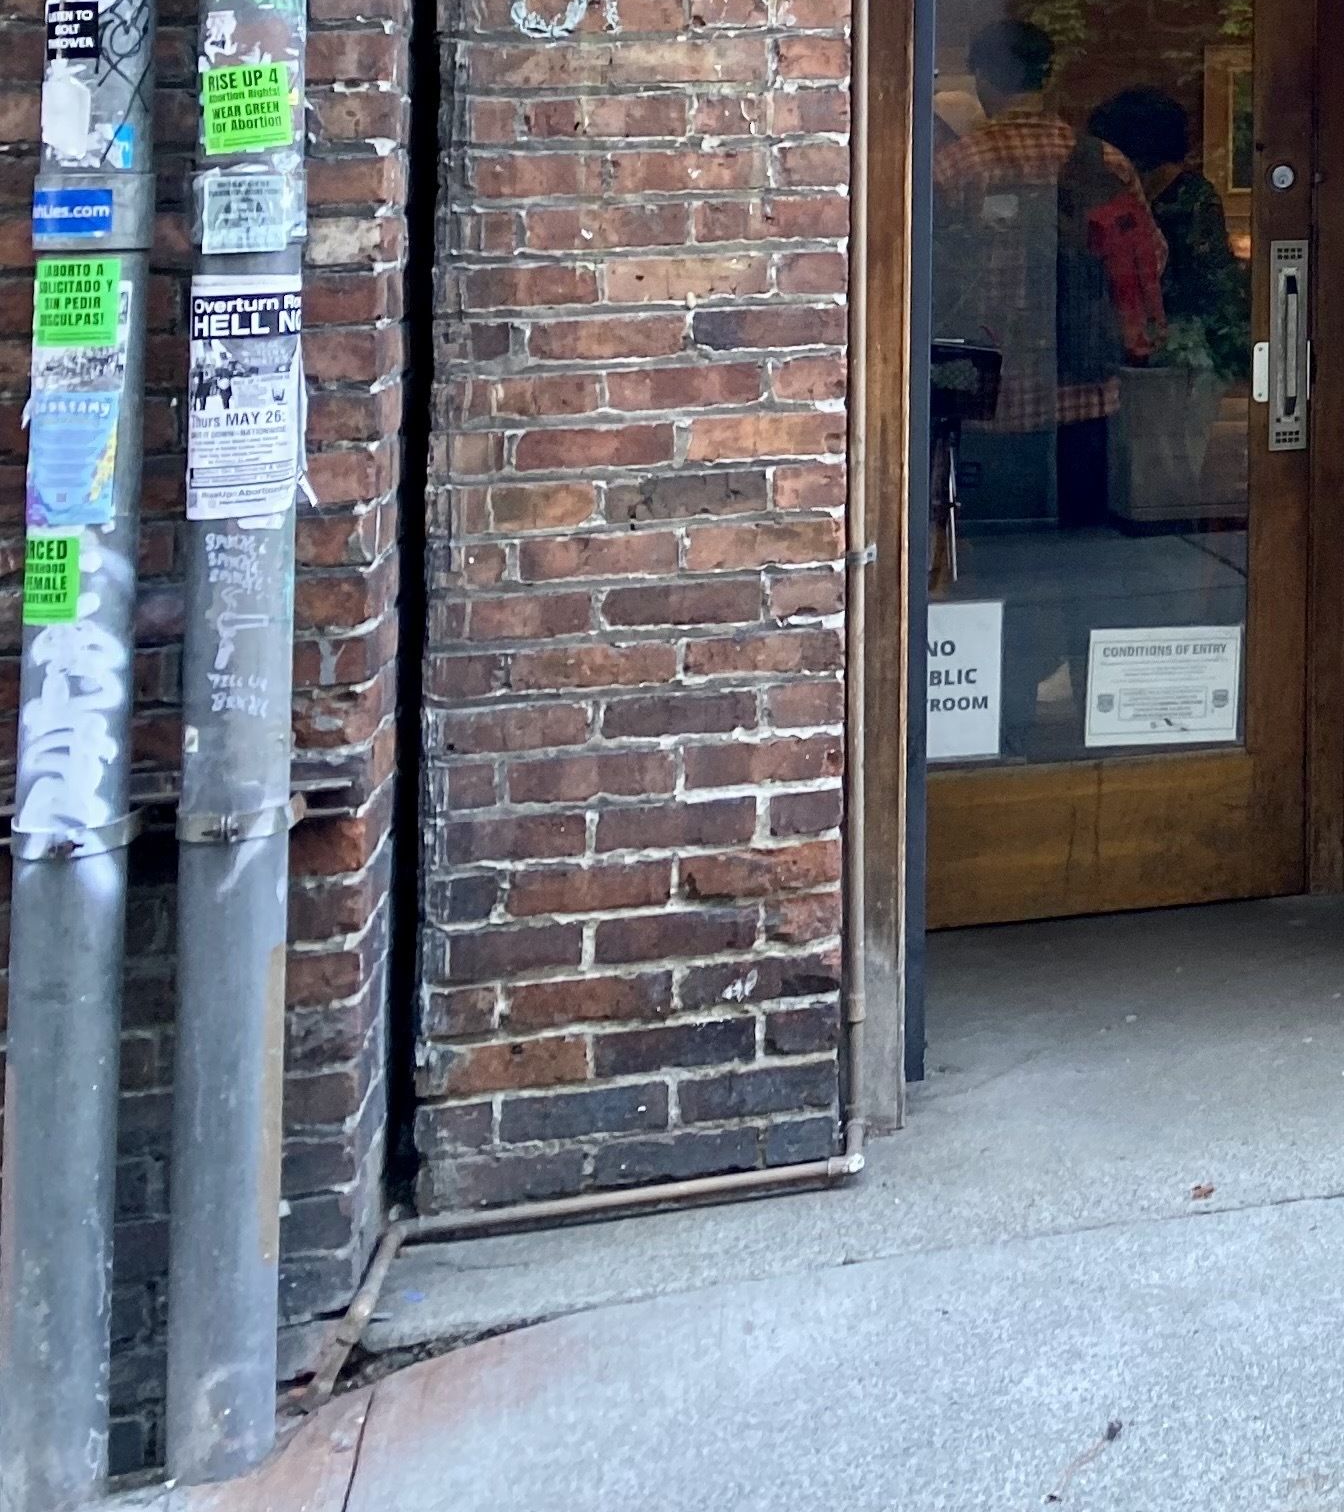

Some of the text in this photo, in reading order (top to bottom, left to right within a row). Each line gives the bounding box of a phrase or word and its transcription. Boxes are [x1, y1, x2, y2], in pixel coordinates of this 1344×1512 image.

[76, 9, 94, 21] TO
[207, 67, 279, 93] RISE UP 4
[212, 100, 280, 121] WEAR GREEN
[230, 115, 283, 133] Abortion
[96, 263, 105, 277] A
[106, 279, 113, 293] Y
[64, 296, 102, 310] PEDIR
[194, 297, 279, 314] Overturn
[194, 312, 271, 337] HELL
[191, 415, 221, 429] Thurs
[225, 411, 261, 427] MAY
[1102, 644, 1227, 658] CONDITIONS OF ENTRY
